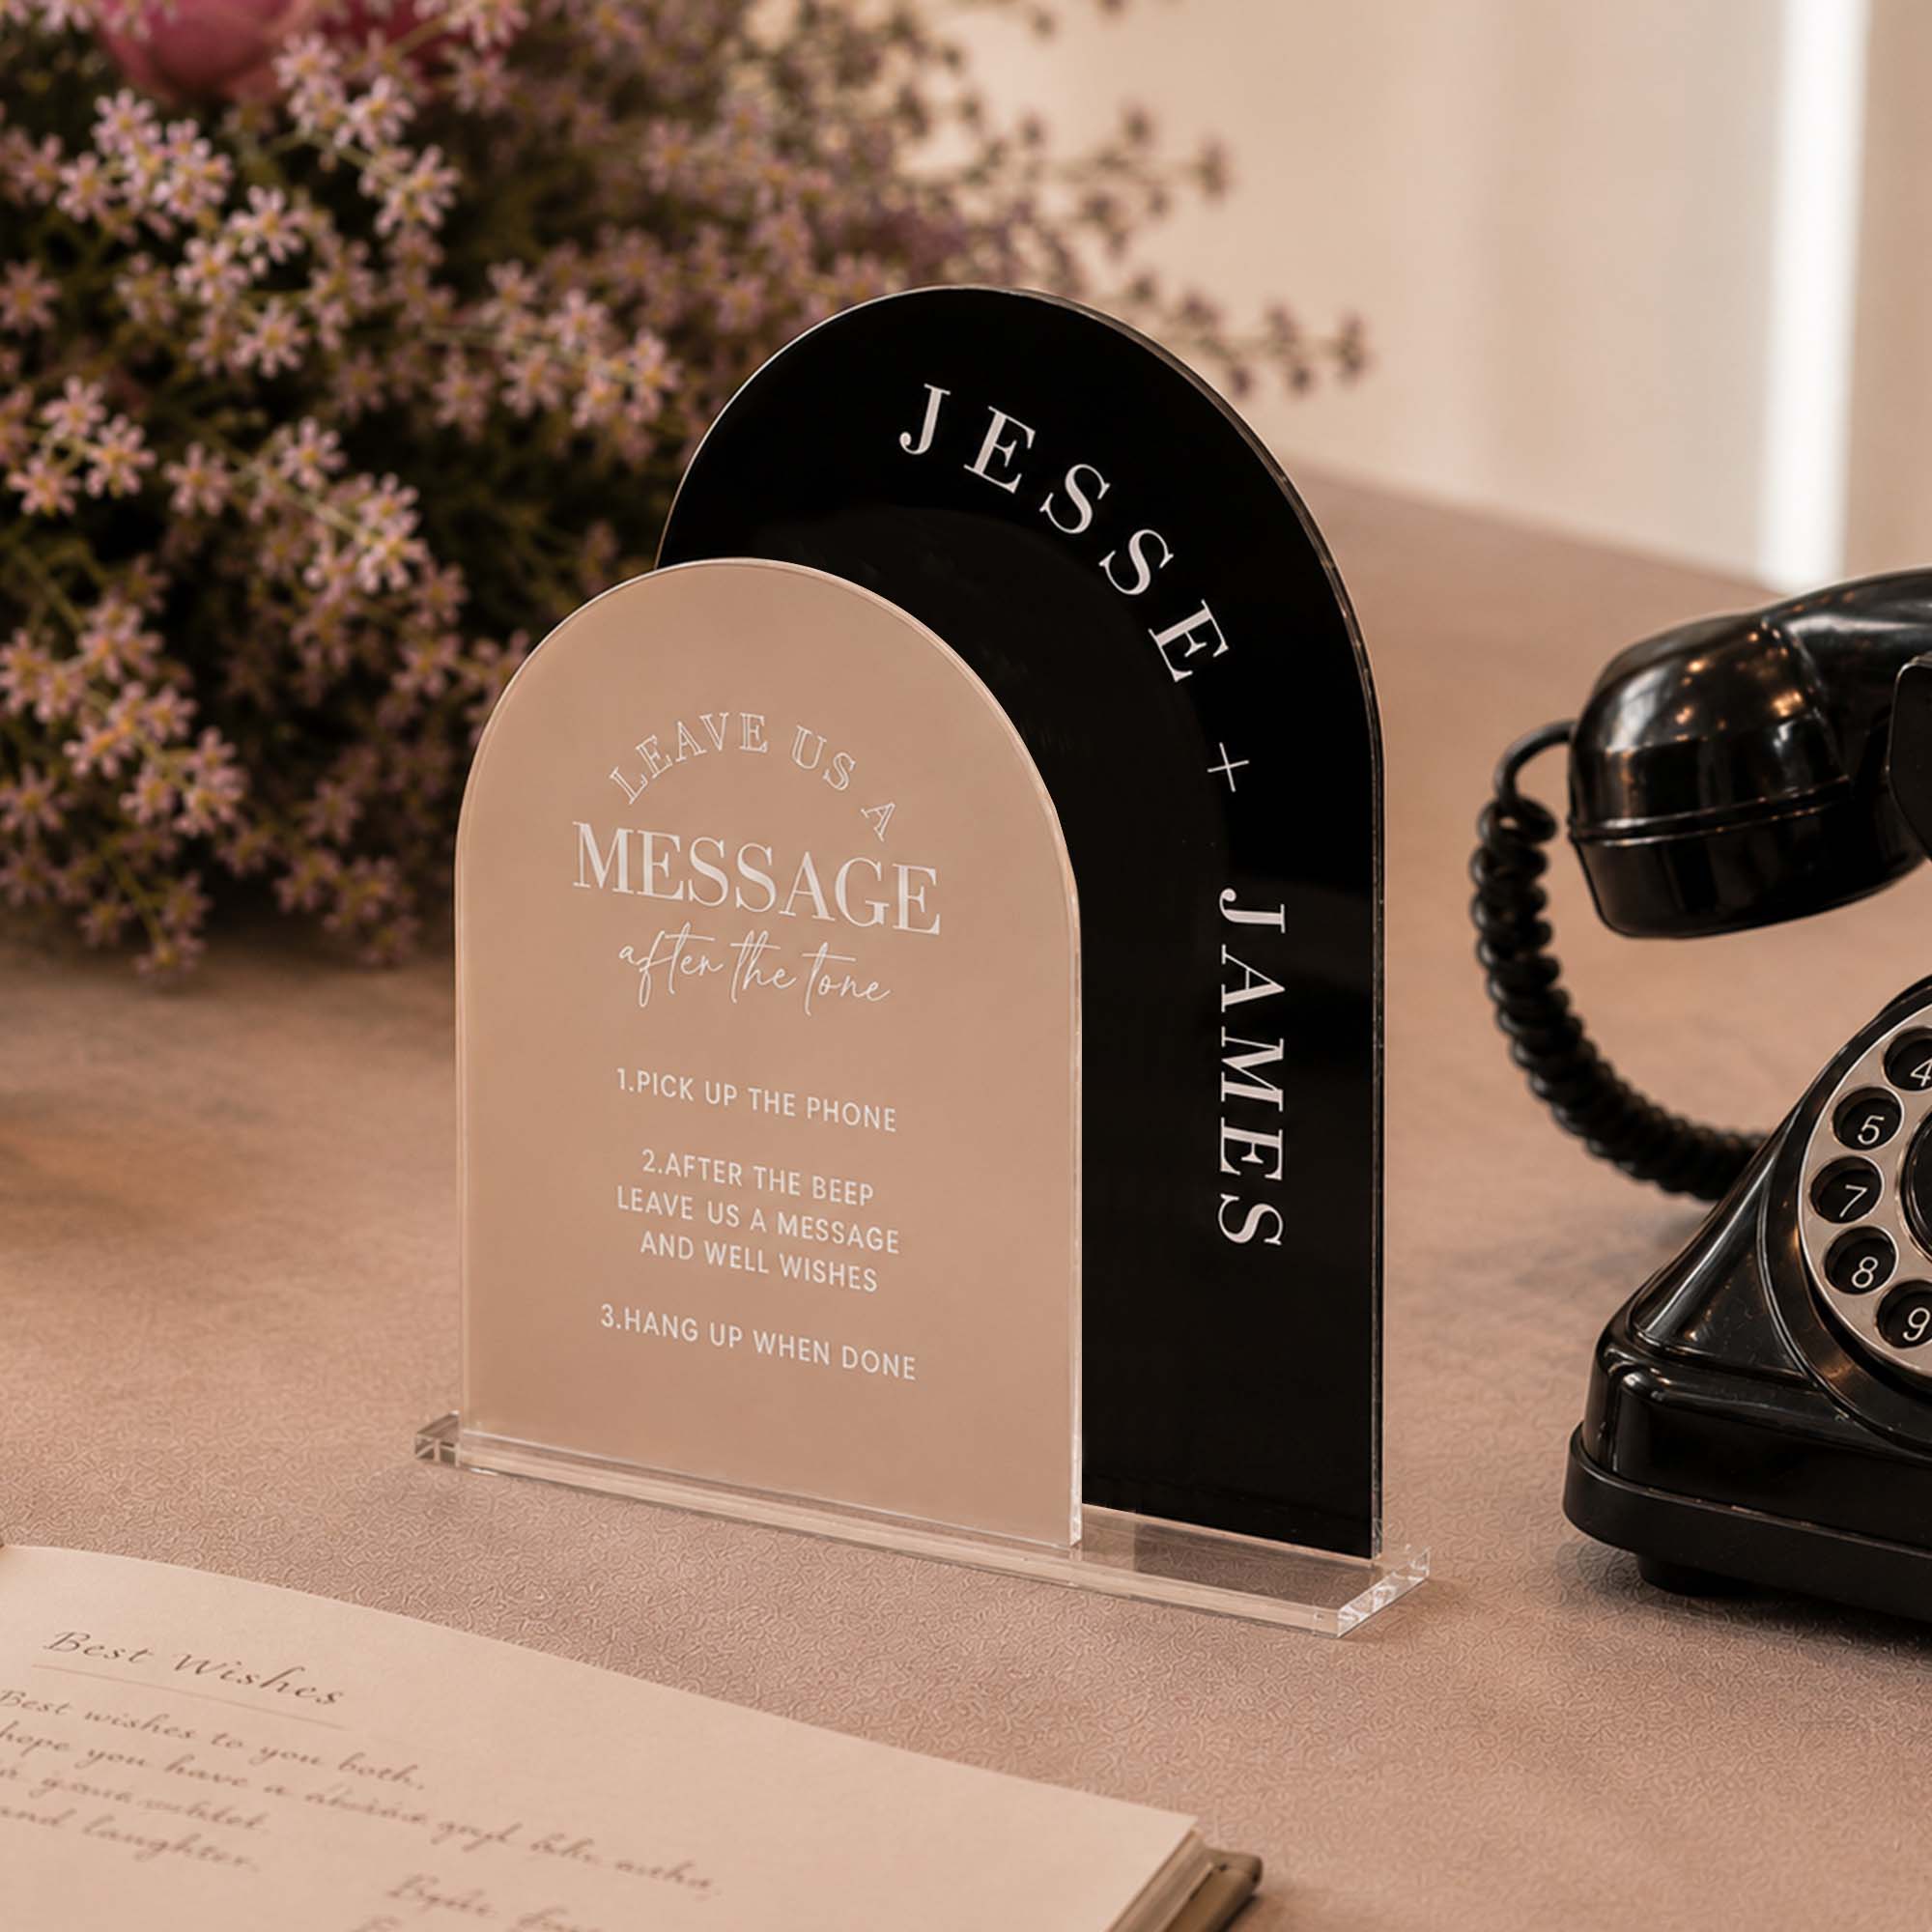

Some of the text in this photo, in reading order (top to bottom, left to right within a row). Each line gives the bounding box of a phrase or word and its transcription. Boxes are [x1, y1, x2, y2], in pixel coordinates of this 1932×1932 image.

[610, 712, 895, 841] LEAVE US A
[898, 384, 1229, 683] JESSE
[1218, 888, 1286, 1246] JAMES
[573, 820, 941, 936] MESSAGE
[619, 922, 891, 1016] after the tone
[616, 1067, 896, 1132] 1.PICK UP THE PHONE
[1909, 1058, 1932, 1088] 4
[1857, 1115, 1885, 1146] 5
[641, 1149, 873, 1207] 2.AFTER THE BEEP
[1839, 1184, 1867, 1218] 7
[617, 1185, 899, 1254] LEAVE US A MESSAGE
[640, 1231, 878, 1293] AND WELL WISHES
[1851, 1256, 1879, 1289] 8
[601, 1303, 916, 1380] 3.HANG UP WHEN DONE
[1902, 1307, 1931, 1343] 9
[43, 1631, 344, 1705] Best Wishes
[0, 1690, 73, 1717] Best
[84, 1712, 195, 1741] wishes
[210, 1733, 244, 1749] to
[248, 1746, 321, 1767] you
[73, 1747, 150, 1770] you
[163, 1753, 248, 1787] have
